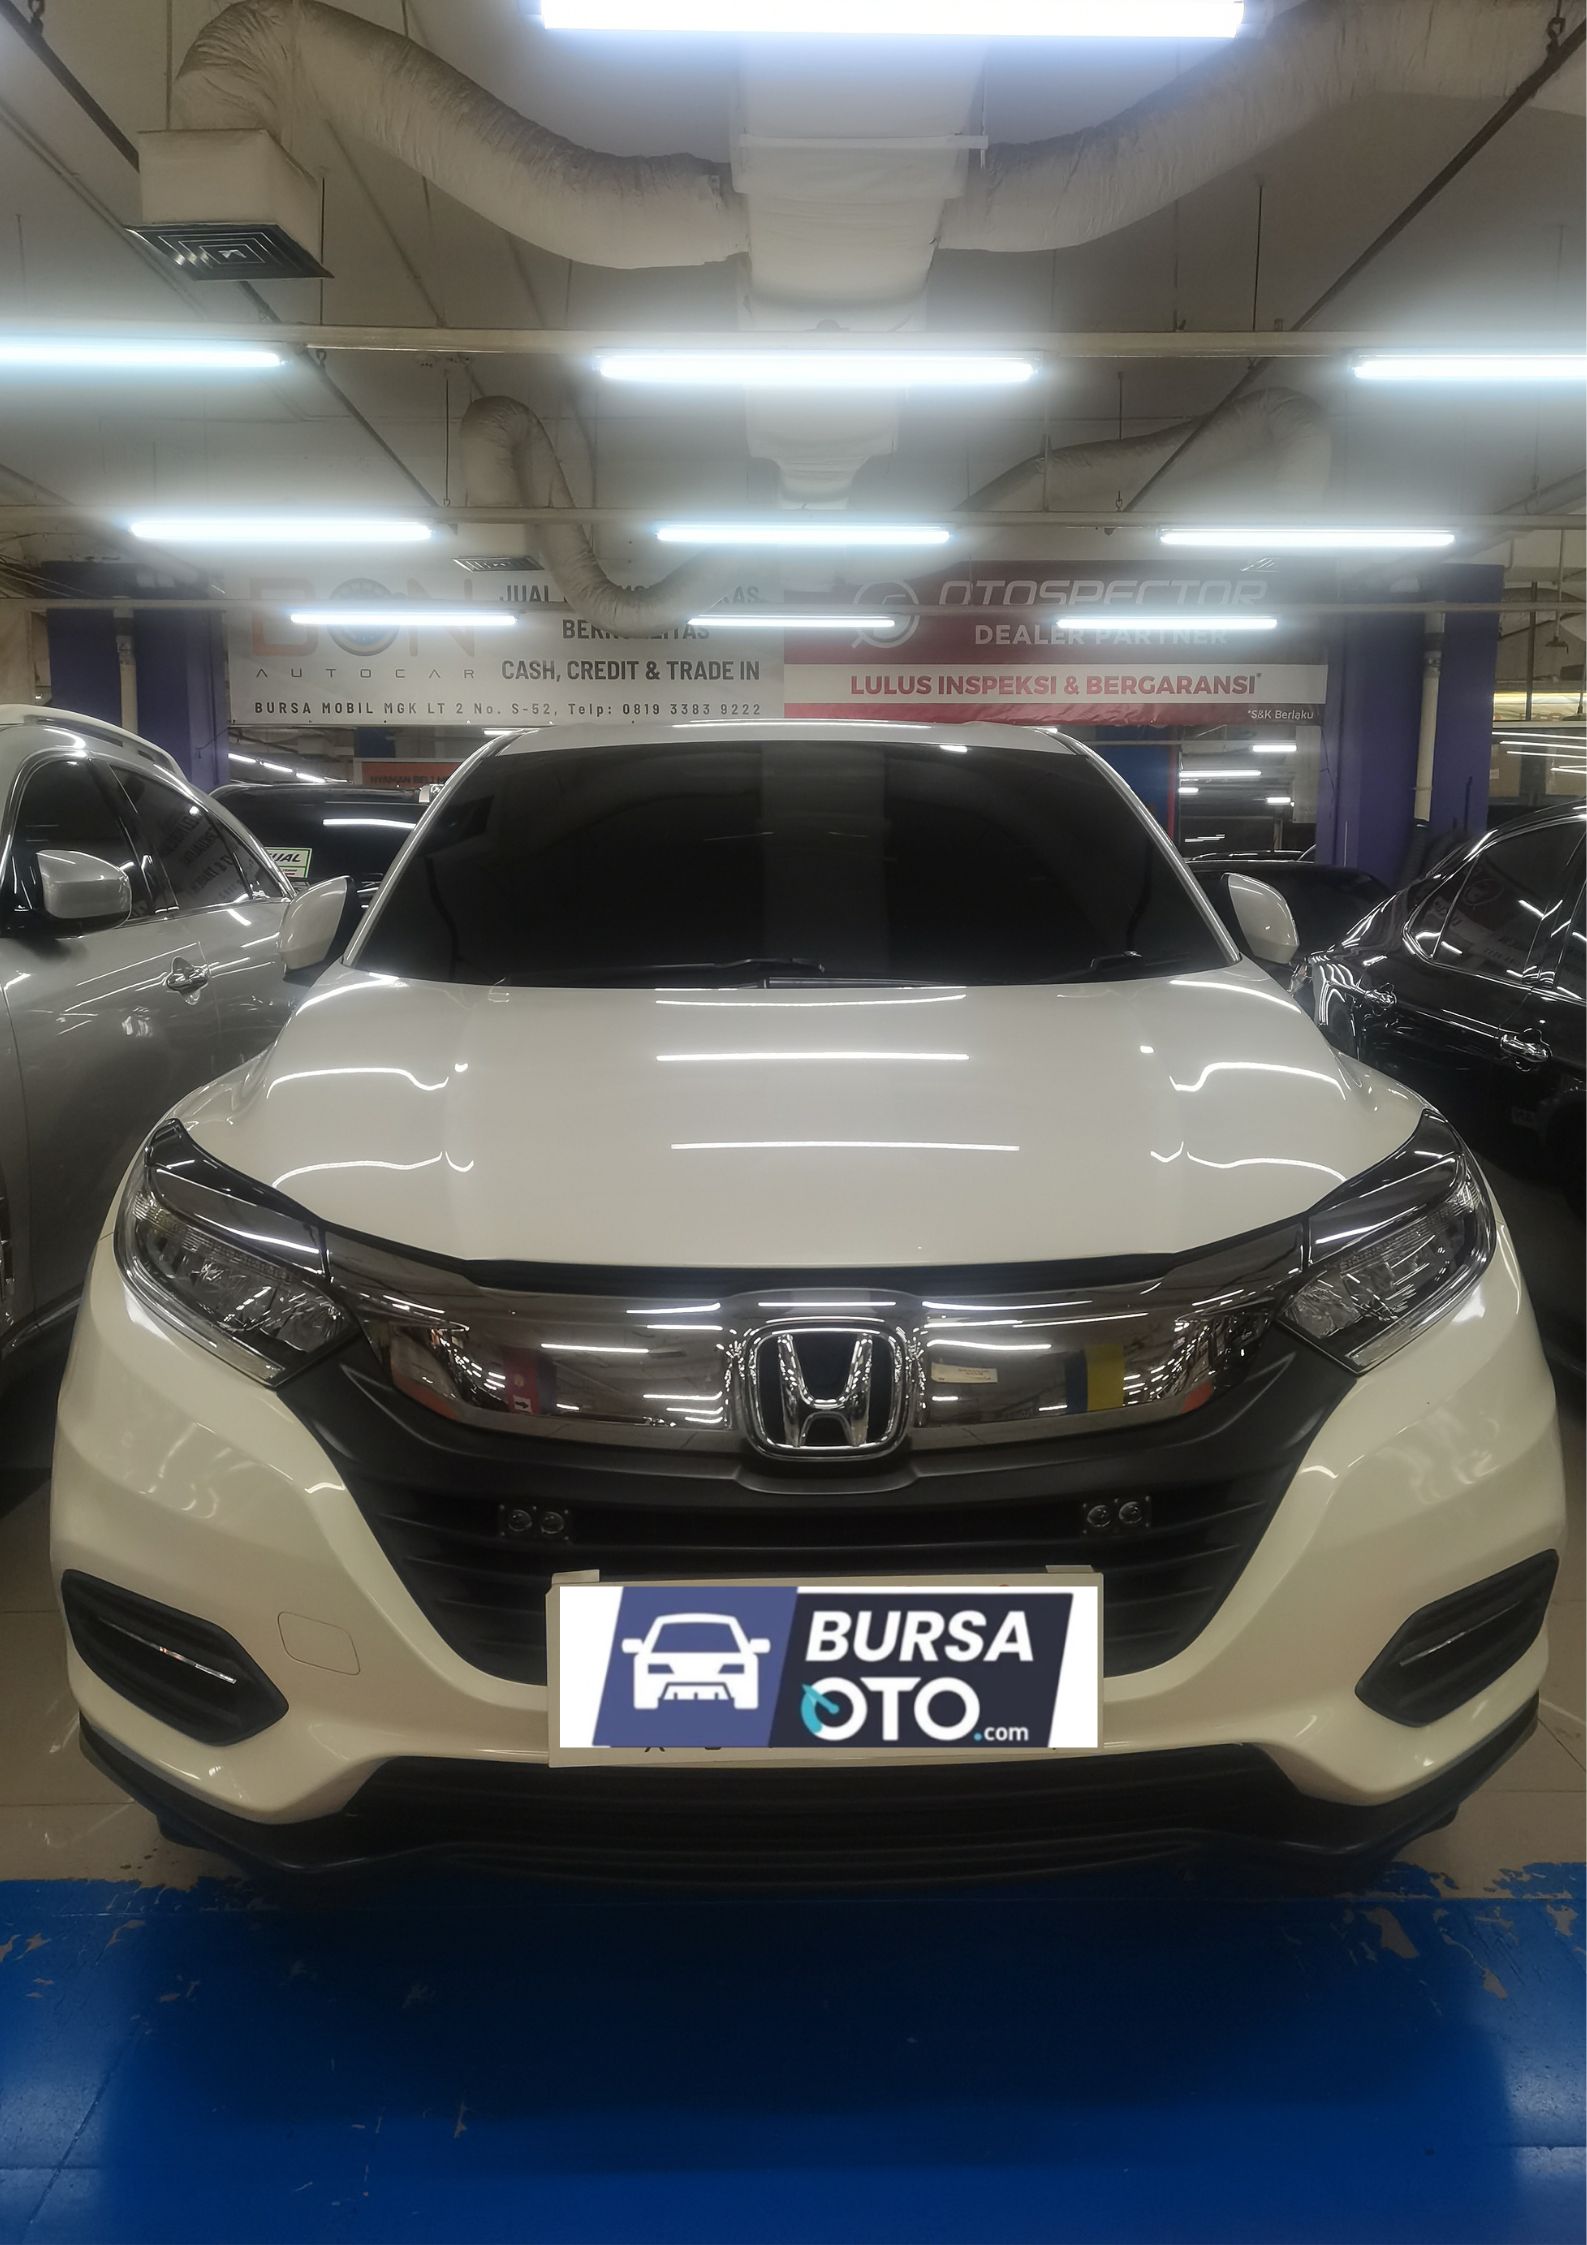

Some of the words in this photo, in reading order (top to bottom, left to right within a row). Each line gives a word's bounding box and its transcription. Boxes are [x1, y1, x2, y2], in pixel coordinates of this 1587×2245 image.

[938, 579, 1269, 606] OTOSPECTOR
[975, 624, 1085, 645] DEALER
[1095, 625, 1228, 645] PARTNER
[255, 667, 475, 679] AUTOCAR
[501, 659, 561, 682] CASH,
[567, 659, 639, 681] CREDIT
[645, 660, 661, 681] &
[666, 660, 735, 681] TRADE
[740, 660, 760, 681] IN
[850, 675, 933, 696] LULUS
[938, 675, 1057, 696] INSPEKSI
[1064, 675, 1081, 696] &
[254, 701, 312, 717] BURSA
[321, 701, 374, 717] MOBIL
[383, 701, 418, 717] MGK
[427, 701, 446, 717] LT
[455, 701, 464, 717] 2
[473, 701, 502, 717] No.
[511, 701, 559, 718] S-52,
[567, 701, 613, 718] Telp:
[622, 701, 661, 717] 0819
[670, 701, 711, 717] 3383
[720, 701, 761, 717] 9222
[1274, 708, 1314, 722] Berlaku
